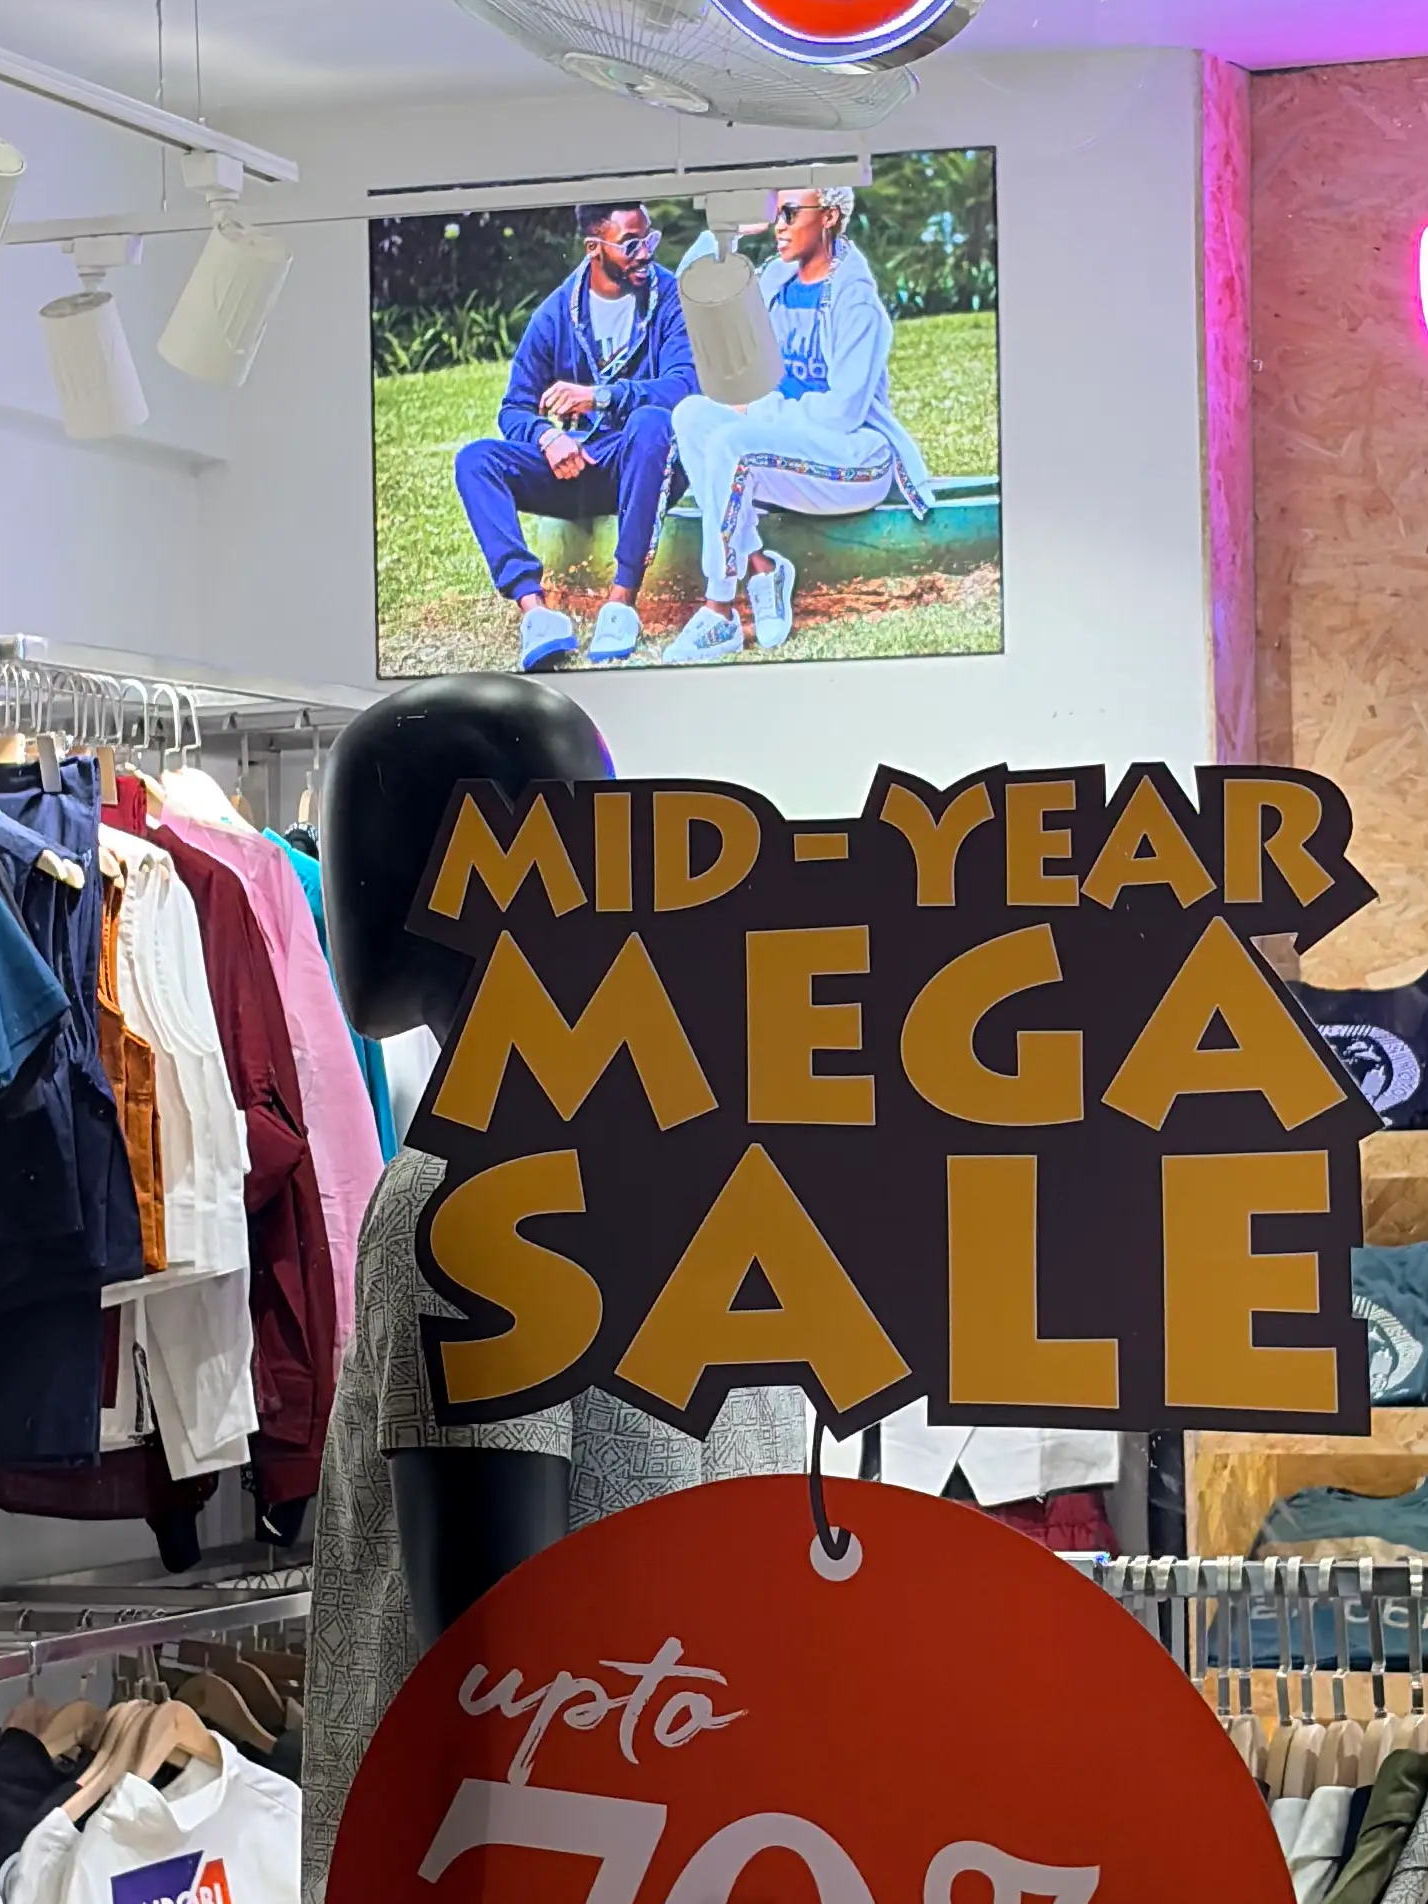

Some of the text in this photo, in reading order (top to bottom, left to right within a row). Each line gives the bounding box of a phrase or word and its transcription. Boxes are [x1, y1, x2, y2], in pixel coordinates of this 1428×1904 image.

[427, 773, 1337, 919] MID-YEAR
[431, 914, 1349, 1132] MEGA
[428, 1142, 1340, 1414] SALE
